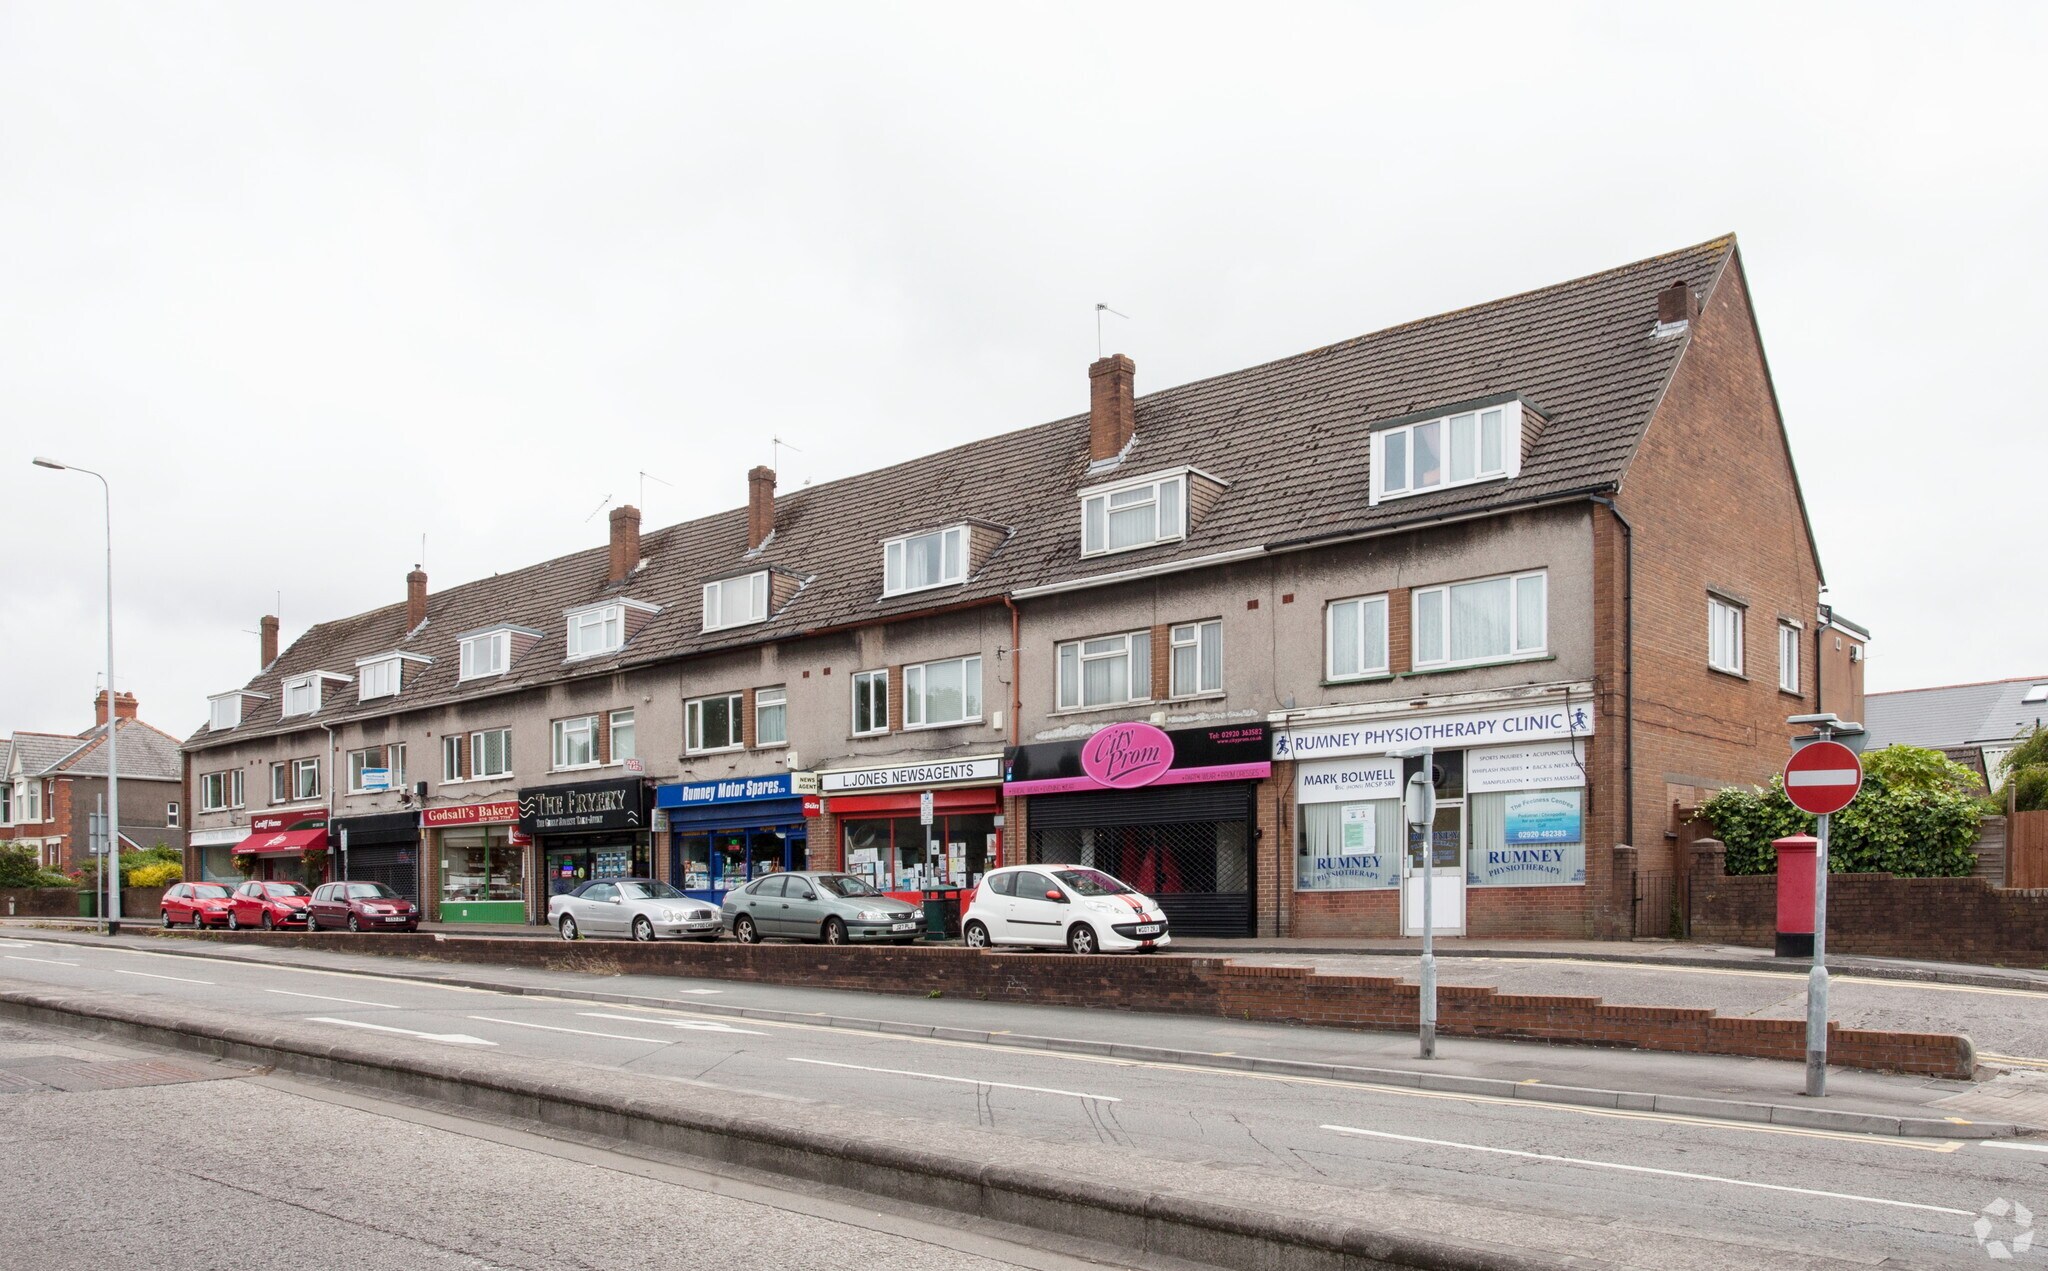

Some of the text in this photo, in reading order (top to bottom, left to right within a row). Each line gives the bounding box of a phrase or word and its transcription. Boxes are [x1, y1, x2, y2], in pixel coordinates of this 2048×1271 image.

[1221, 730, 1239, 738] 02920
[1295, 713, 1563, 751] RUMNEY PHYSIOTHERAPY CLINIC
[1094, 728, 1134, 763] City
[1106, 746, 1160, 777] Prom
[842, 763, 974, 787] L.JONES NEWSAGENTS
[1304, 769, 1395, 786] MARK BOLWELL
[682, 786, 715, 801] Rumney
[718, 781, 745, 799] Motor
[746, 780, 779, 798] Spares
[1364, 781, 1382, 789] MCSP
[535, 789, 626, 816] THE FRYERY
[1510, 803, 1522, 811] The
[1550, 797, 1574, 809] Centres
[428, 805, 515, 821] Godsall's Bakery
[1518, 831, 1539, 839] 02920
[1317, 856, 1383, 869] RUMNEY
[1489, 848, 1565, 864] RUMNEY
[1317, 869, 1380, 881] PHYSIOTHERAPY
[1488, 863, 1562, 877] PHYSIOTHERAPY
